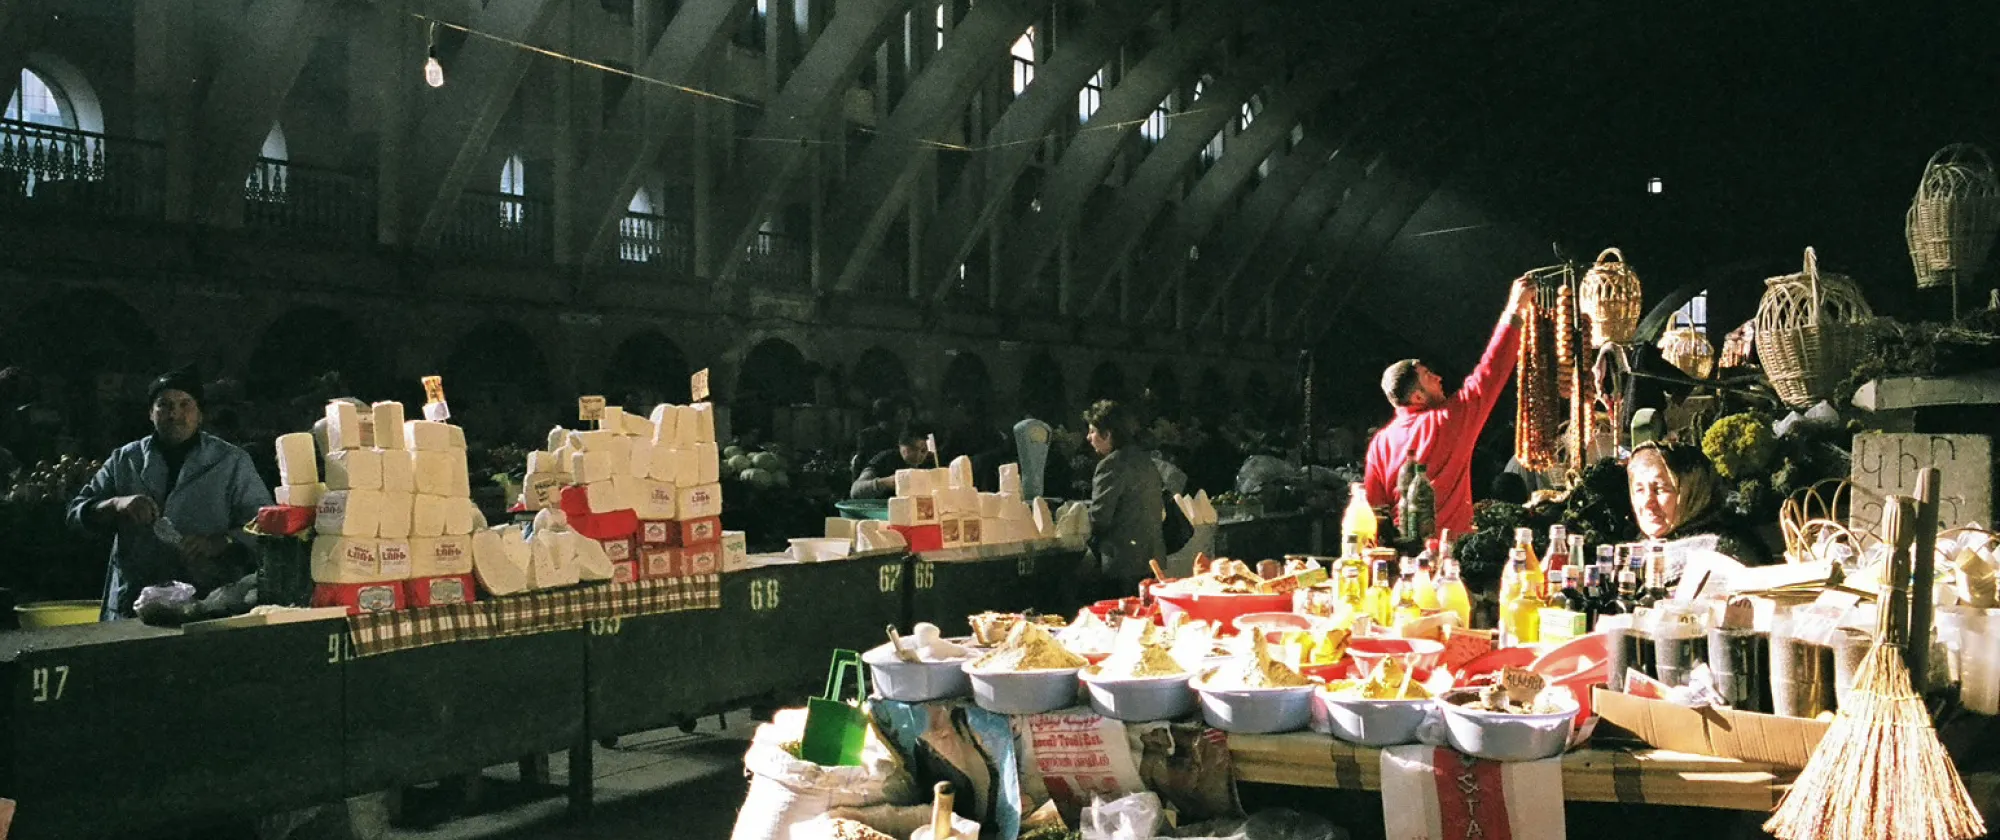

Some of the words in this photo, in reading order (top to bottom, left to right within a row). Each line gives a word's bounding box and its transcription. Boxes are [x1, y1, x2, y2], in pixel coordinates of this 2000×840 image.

[880, 564, 901, 592] 67
[915, 562, 935, 588] 66
[750, 579, 779, 610] 68
[33, 665, 69, 702] 97
